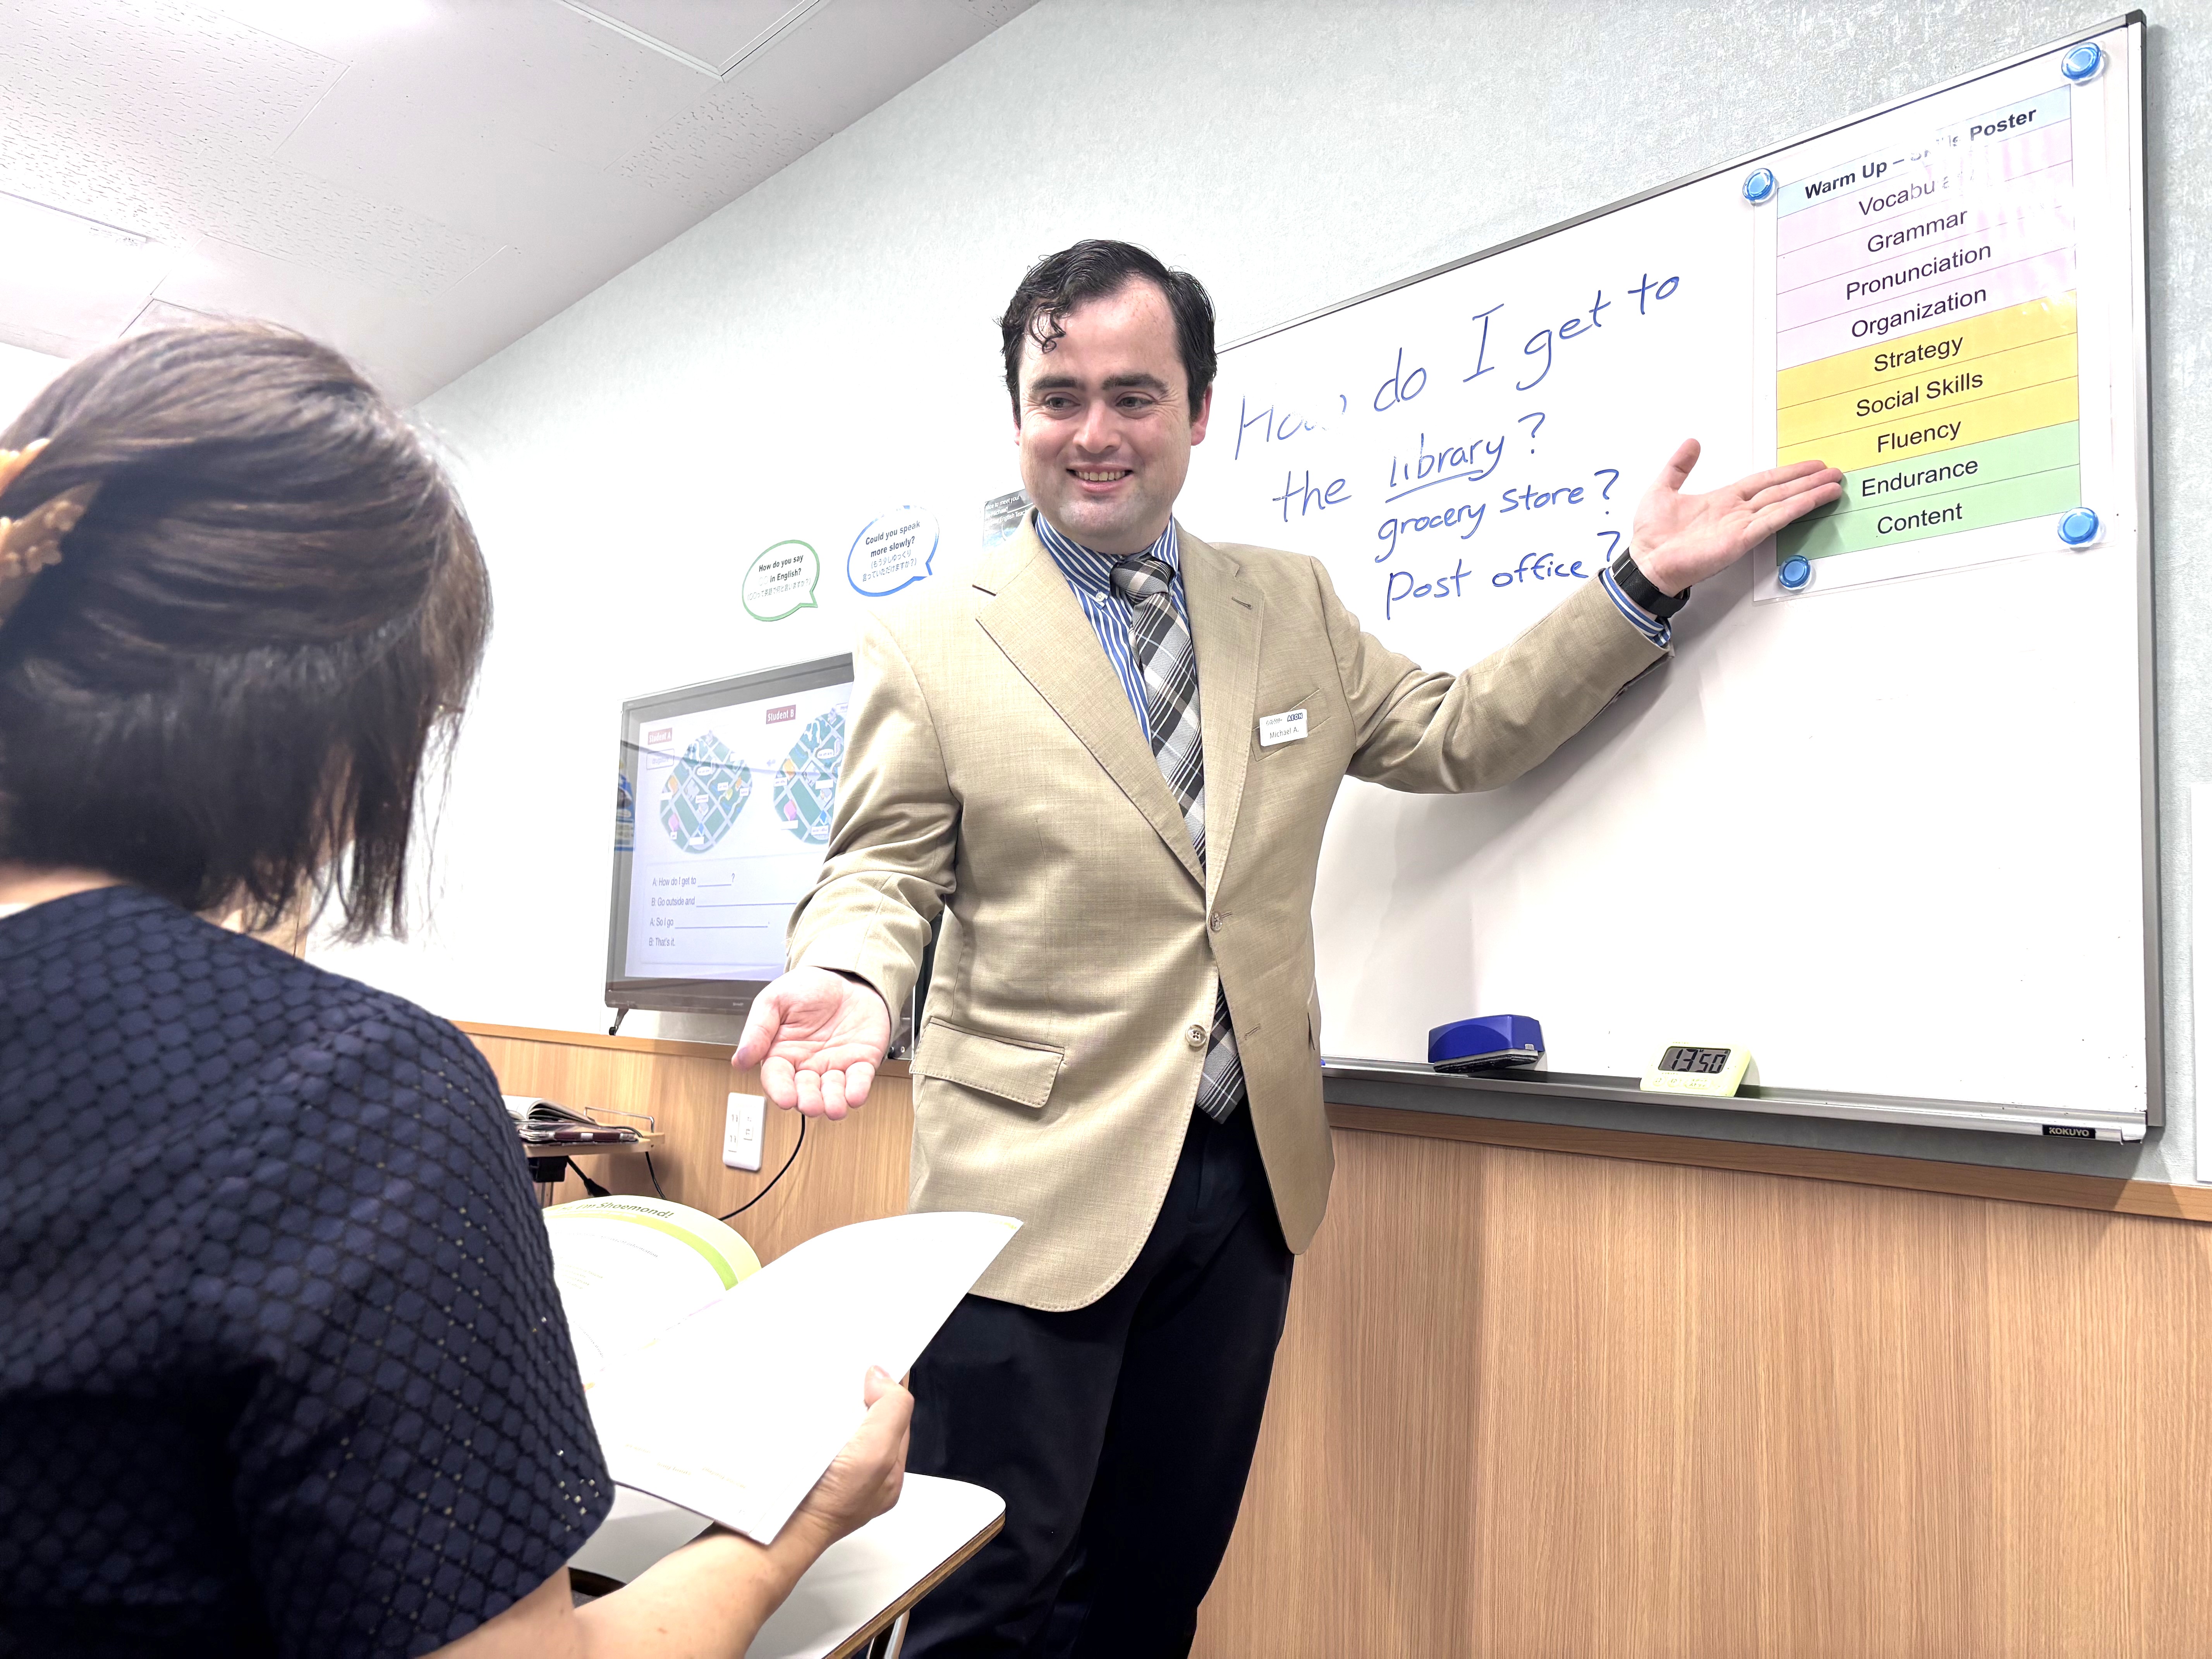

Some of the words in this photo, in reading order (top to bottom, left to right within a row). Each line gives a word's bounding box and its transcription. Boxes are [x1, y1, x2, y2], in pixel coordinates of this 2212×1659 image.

[1805, 172, 1855, 199] Warm
[1862, 161, 1887, 179] Up
[1970, 109, 2037, 141] Poster
[1867, 208, 1968, 252] Grammar
[1846, 243, 1991, 301] Pronunciation
[1851, 289, 1987, 338] Organization
[1374, 347, 1426, 412] do
[1463, 303, 1504, 383] I
[1516, 290, 1611, 390] get
[1628, 273, 1680, 315] to
[1874, 336, 1963, 372] Strategy
[1856, 385, 1919, 417] Social
[1926, 371, 1984, 400] Skills
[1878, 421, 1962, 453] Fluency
[1862, 460, 1978, 497] Endurance
[1273, 470, 1352, 522] the
[1877, 502, 1963, 535] Content
[866, 532, 884, 545] Could
[886, 530, 897, 543] you
[900, 520, 920, 534] speak
[1375, 503, 1486, 563] grocery
[871, 547, 887, 557] more
[889, 536, 915, 551] slowly?
[781, 558, 792, 568] you
[793, 555, 804, 563] say
[777, 568, 801, 581] English?
[768, 711, 788, 722] Student
[790, 709, 794, 718] B
[1287, 713, 1303, 722] AEON
[649, 732, 666, 743] Student
[667, 731, 671, 740] A
[1270, 727, 1291, 739] Michael
[659, 877, 670, 886] How
[671, 877, 678, 886] do
[682, 877, 690, 887] get
[691, 876, 696, 885] to
[658, 897, 665, 906] Go
[666, 896, 684, 906] outside
[685, 896, 695, 905] and
[656, 917, 663, 926] So
[667, 919, 673, 928] go
[656, 938, 670, 946] That's
[2049, 1127, 2090, 1137] KOKUYO
[596, 1202, 674, 1218] Shoemond!
